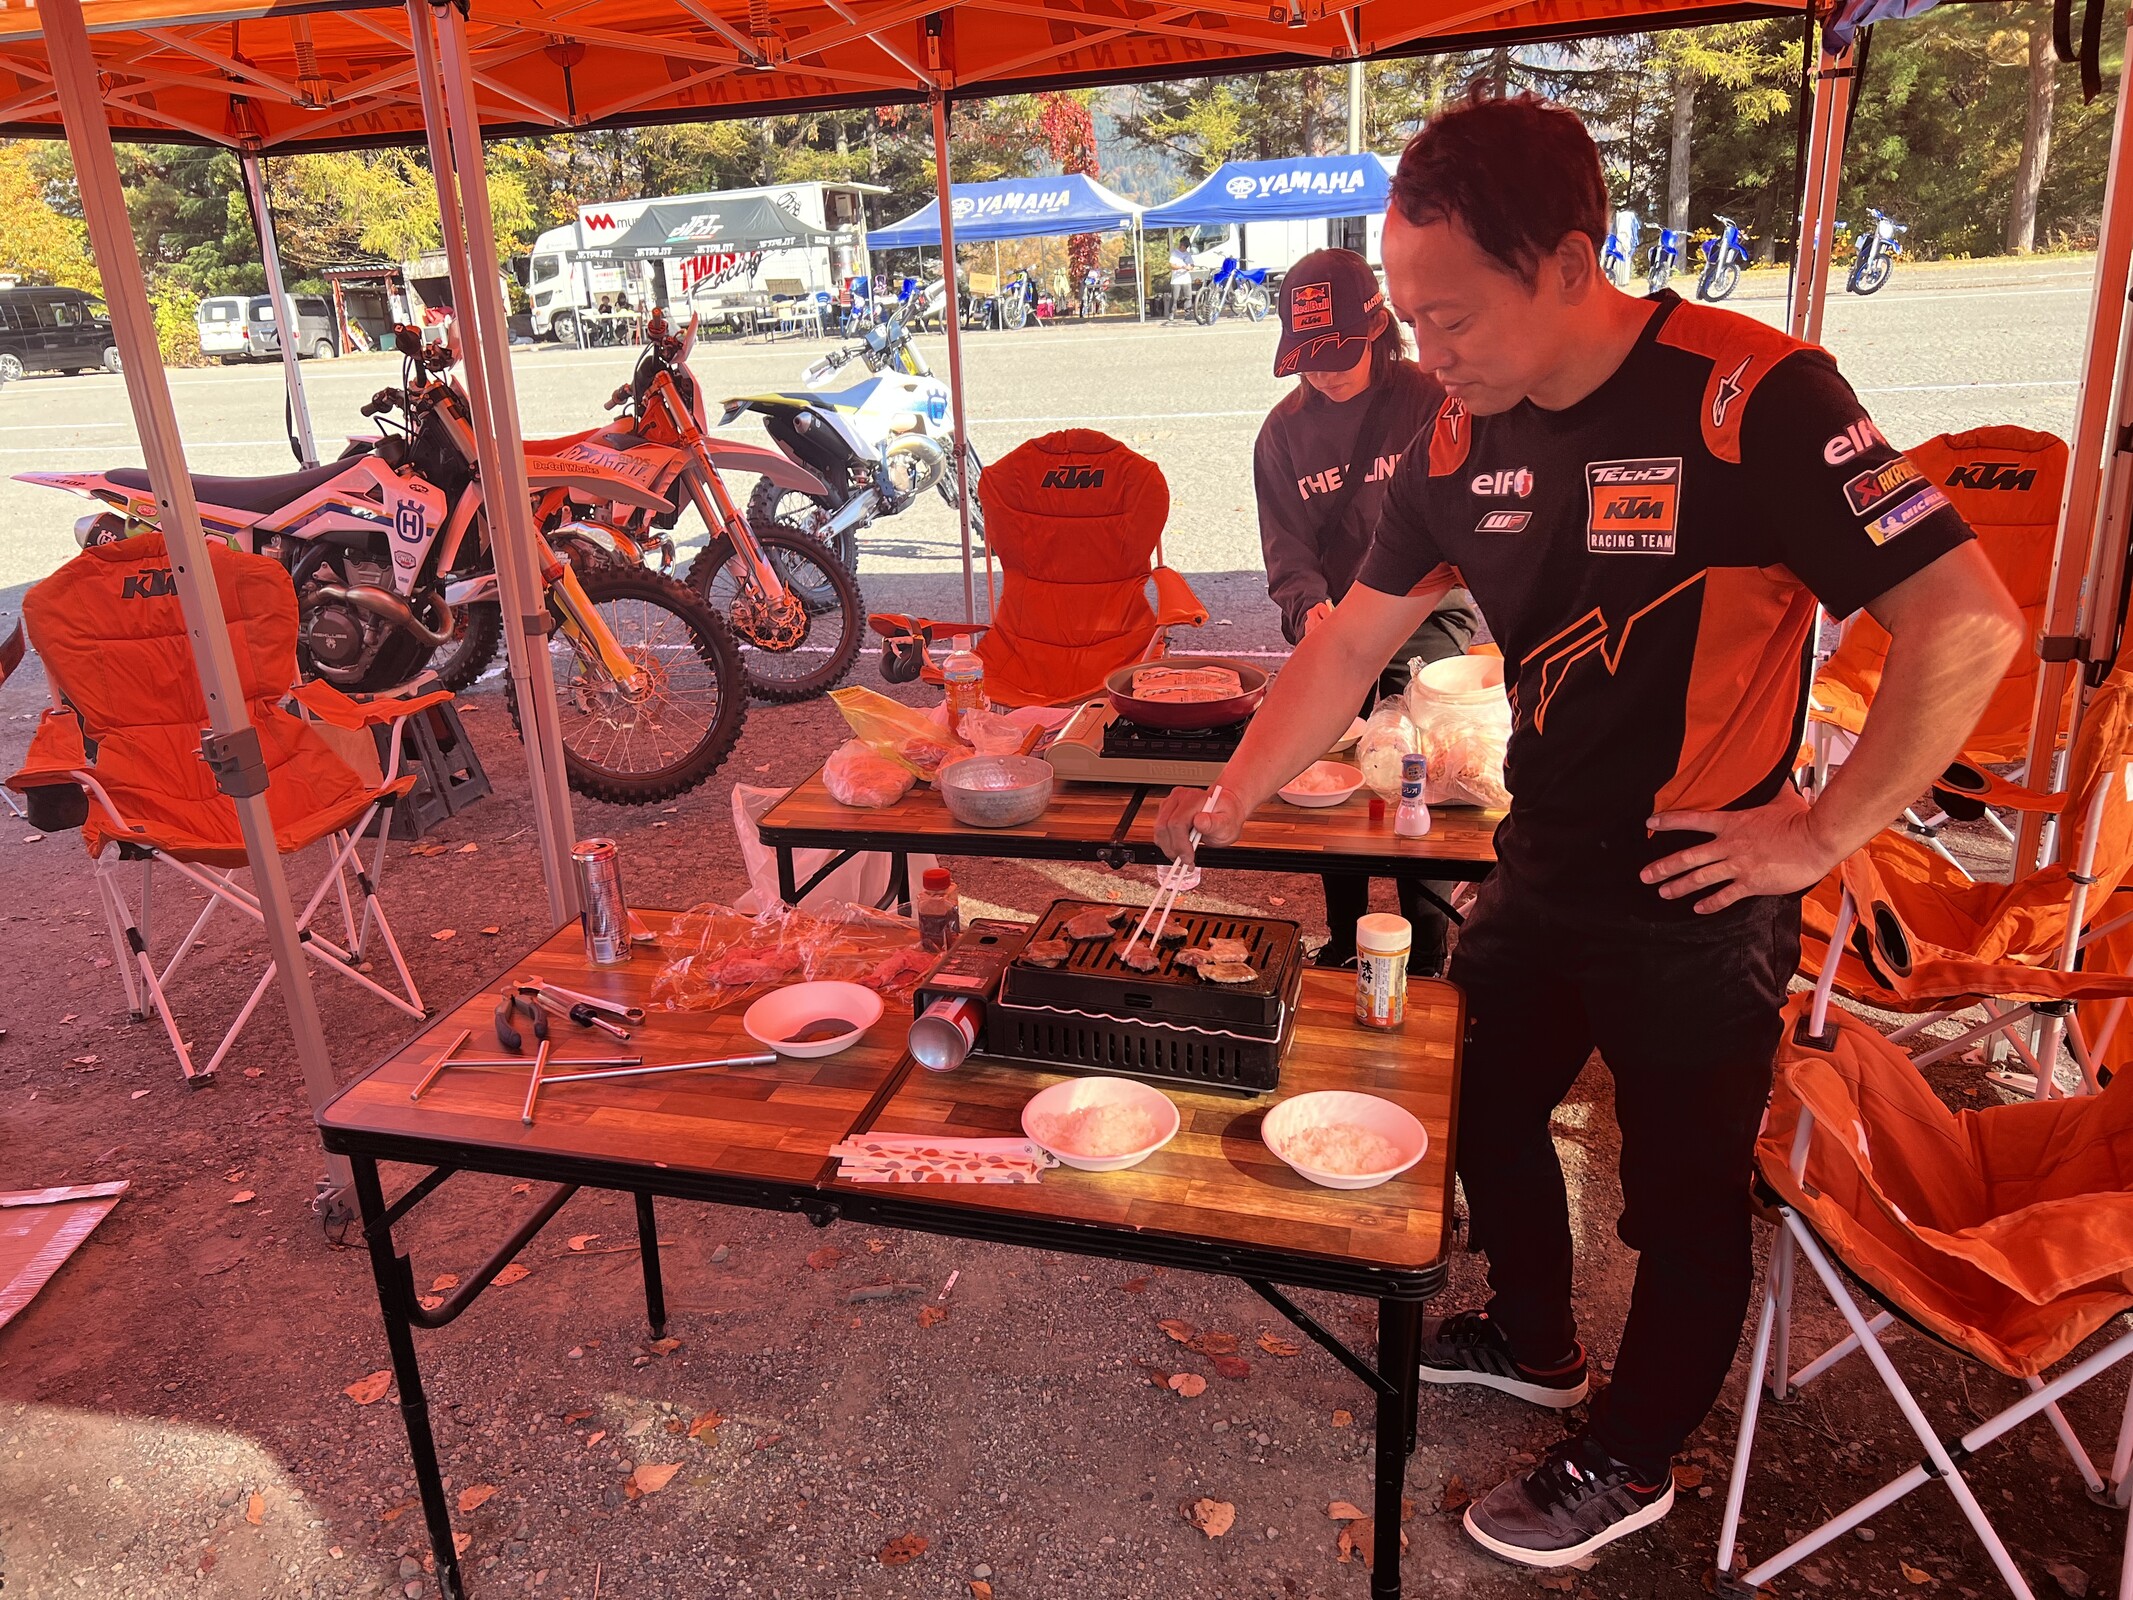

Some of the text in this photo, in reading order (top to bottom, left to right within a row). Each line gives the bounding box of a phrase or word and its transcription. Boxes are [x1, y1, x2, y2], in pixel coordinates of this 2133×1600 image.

[1259, 169, 1365, 192] YAMAHA
[977, 189, 1070, 213] YAMAHA
[689, 214, 721, 227] JET
[1301, 315, 1322, 326] KTM
[565, 463, 600, 475] Works
[1040, 464, 1104, 489] KTM
[1591, 466, 1677, 483] TECH3
[1944, 461, 2038, 491] KTM
[1297, 466, 1344, 501] THE
[1471, 471, 1515, 495] elf
[1602, 495, 1665, 520] KTM
[1591, 534, 1673, 549] RACING TEAM
[1150, 764, 1203, 777] Iwatani
